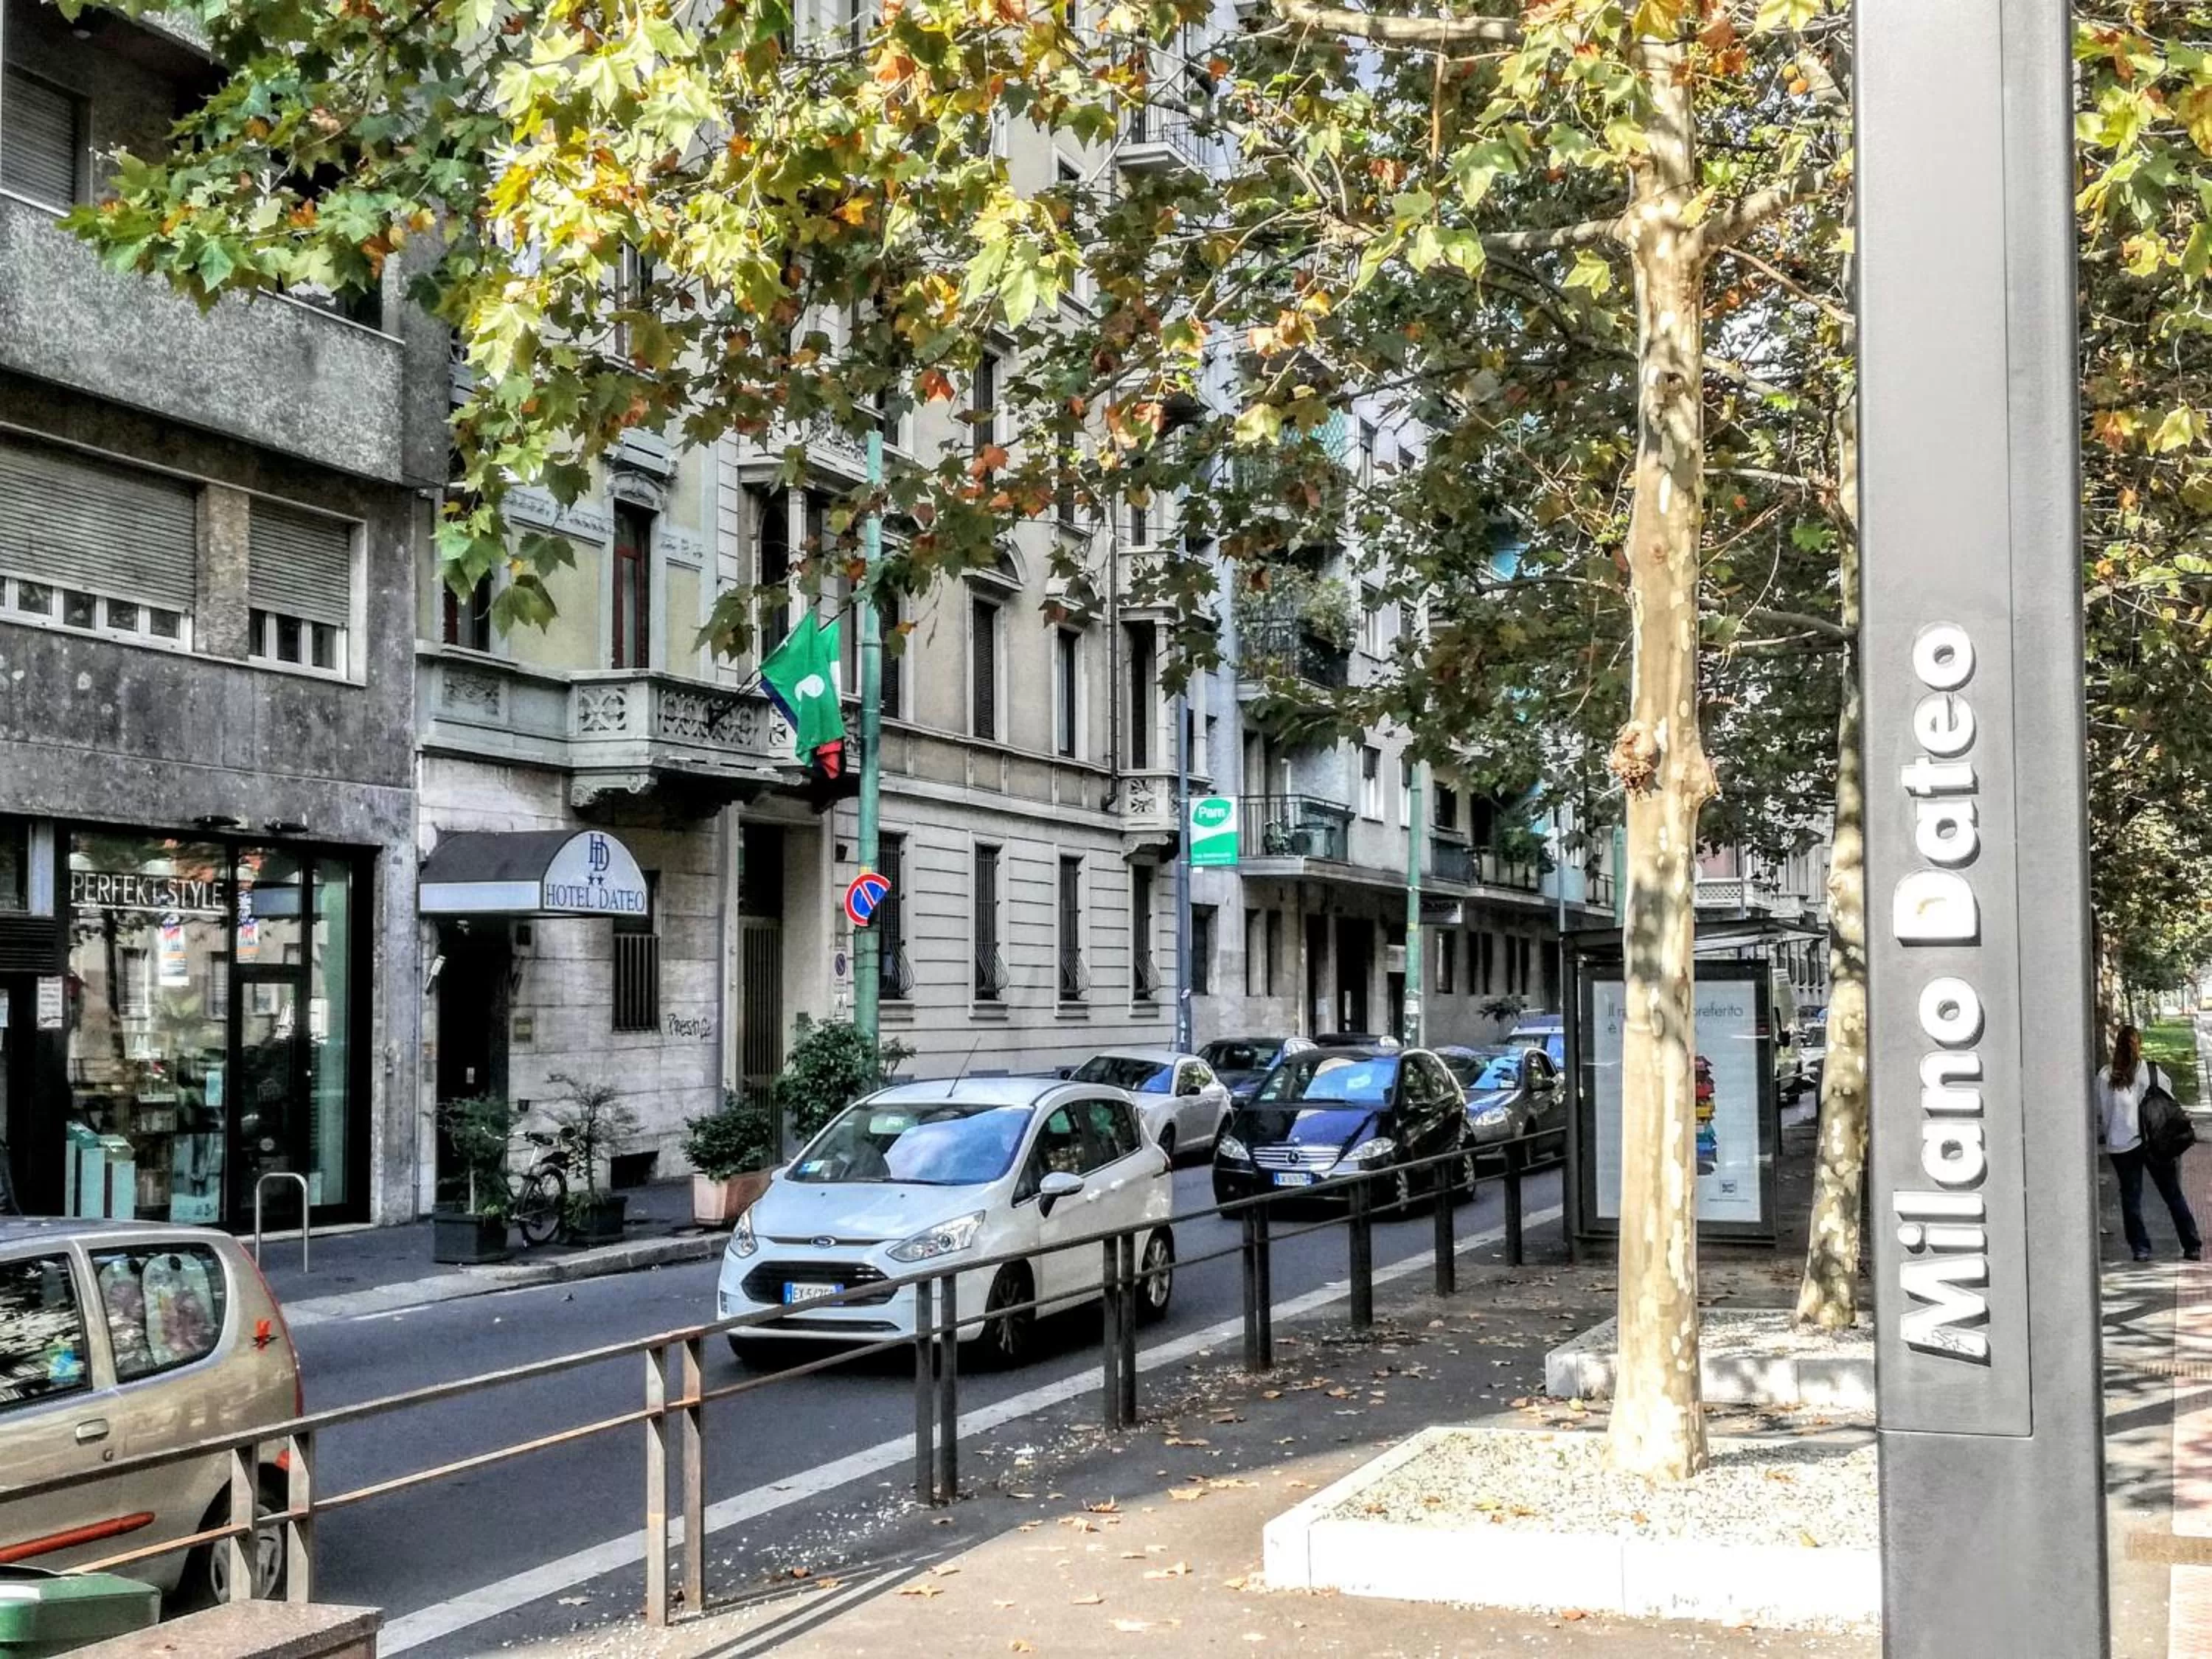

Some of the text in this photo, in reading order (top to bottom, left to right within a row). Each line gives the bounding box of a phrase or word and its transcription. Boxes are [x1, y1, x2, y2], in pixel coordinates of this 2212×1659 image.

[1198, 806, 1226, 818] Pam
[70, 872, 225, 909] PERFEKT STYLE
[546, 884, 645, 912] HOTEL DATEO
[1893, 621, 1990, 1366] Milano Dateo
